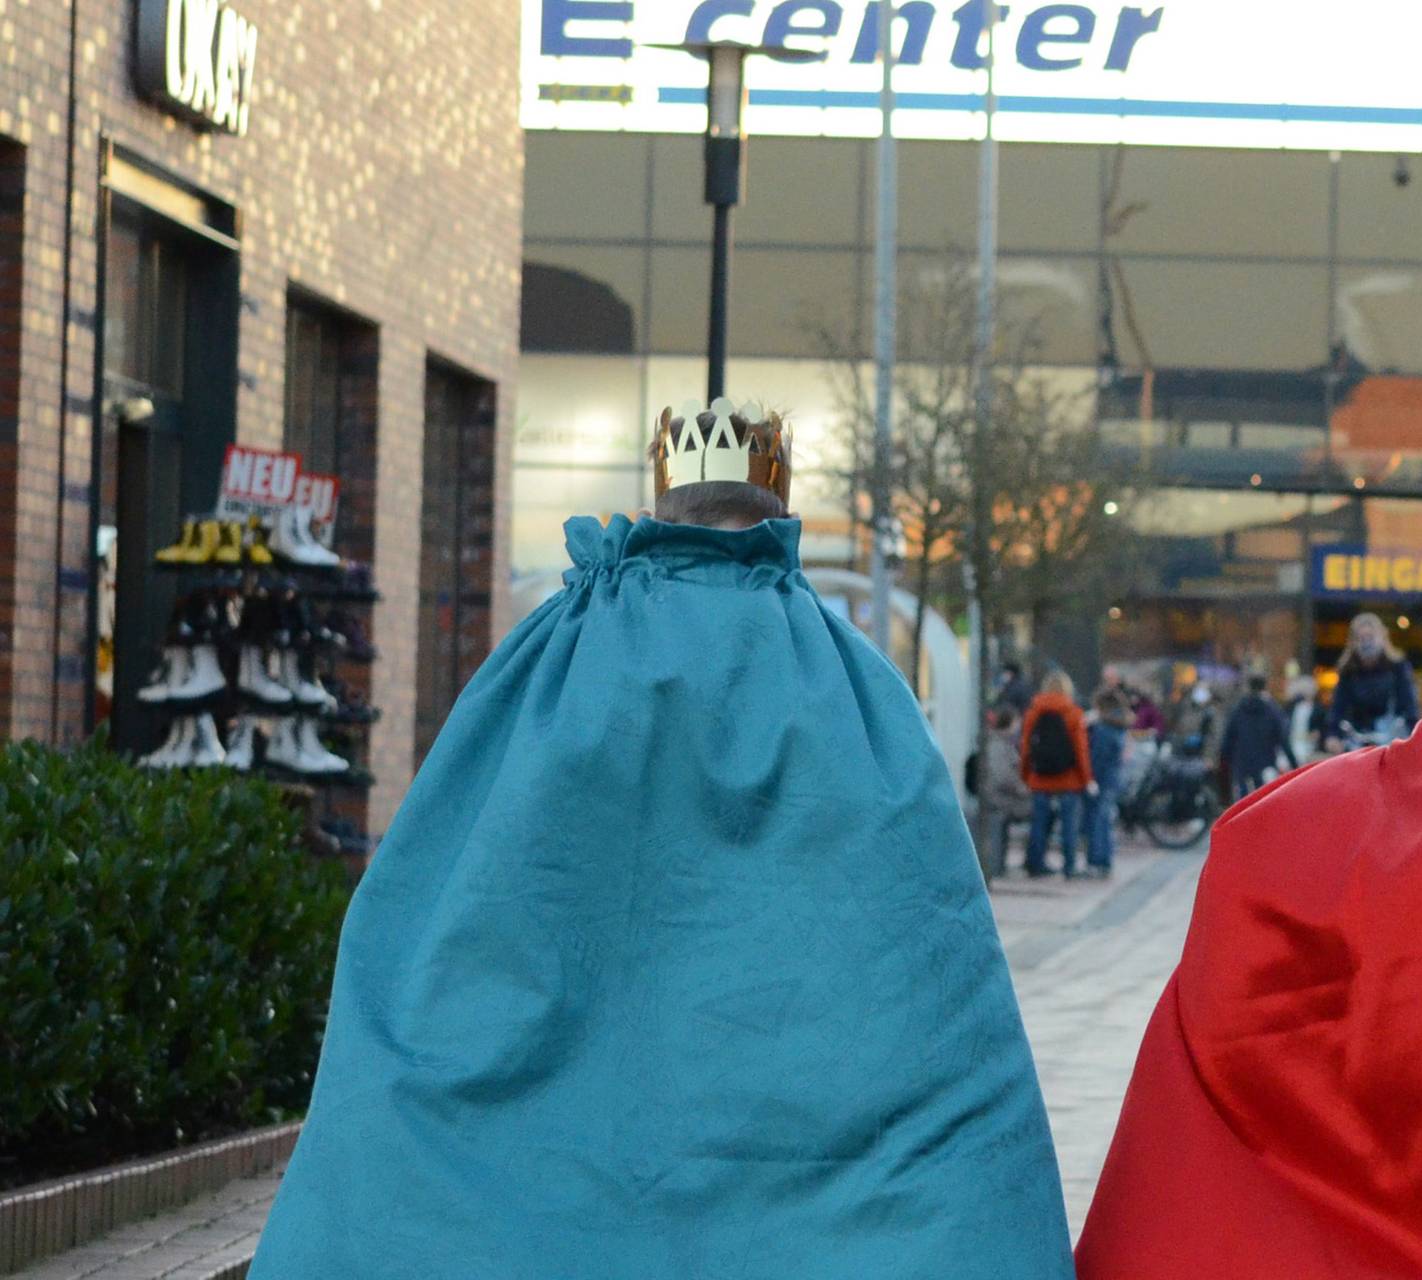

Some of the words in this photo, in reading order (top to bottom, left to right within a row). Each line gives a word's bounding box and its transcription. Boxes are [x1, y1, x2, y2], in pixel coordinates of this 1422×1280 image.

[541, 0, 634, 57] E
[684, 0, 1164, 71] center
[227, 450, 297, 500] NEU
[297, 474, 335, 519] EU
